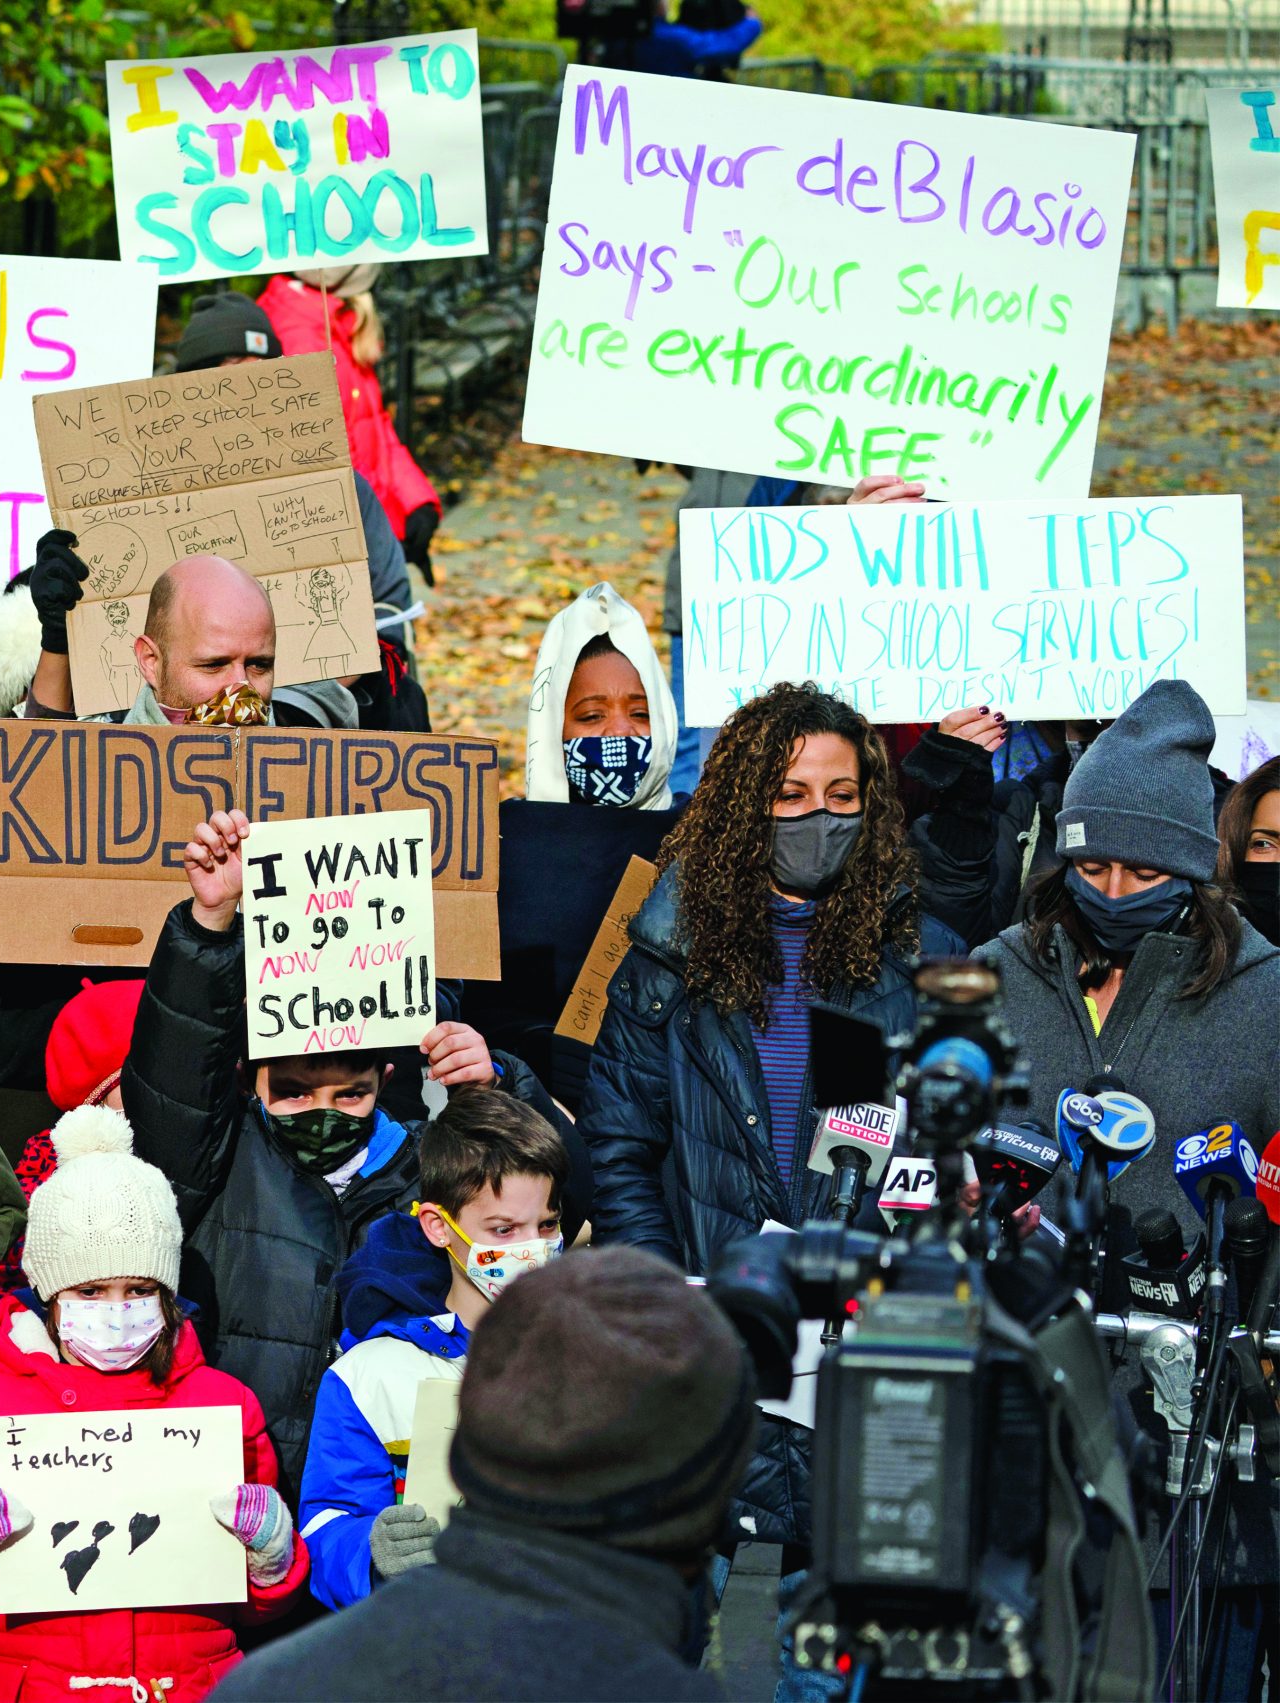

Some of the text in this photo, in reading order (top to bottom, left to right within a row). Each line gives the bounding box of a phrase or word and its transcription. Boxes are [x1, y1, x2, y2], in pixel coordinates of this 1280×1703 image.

[122, 42, 475, 133] I WANT TO
[176, 109, 390, 185] STAY IN
[575, 80, 784, 234] Mayor
[135, 169, 475, 275] SCHOOL
[55, 397, 105, 430] WE
[183, 378, 238, 400] OUR
[247, 369, 302, 399] JOB
[136, 414, 186, 441] KEEP
[192, 404, 267, 429] SCHOOL
[271, 392, 321, 415] SAFE
[540, 319, 1094, 481] are extraordinarily
[57, 457, 110, 485] DO
[132, 438, 196, 493] YOUR
[213, 433, 254, 463] JOB
[291, 418, 333, 440] KEEP
[203, 454, 284, 483] REOPEN
[291, 441, 337, 463] OUR
[178, 526, 202, 542] OUR
[271, 528, 288, 541] GO
[711, 510, 829, 585] KIDS
[848, 507, 989, 591] WITH
[89, 564, 114, 593] BARS
[688, 592, 791, 682] NEED
[808, 597, 847, 675] IN
[862, 601, 981, 672] SCHOOL
[245, 735, 498, 881] FIRST
[248, 838, 423, 900] I WANT
[305, 880, 361, 915] NOW
[311, 916, 349, 950] go
[259, 936, 416, 984] NOW NOW
[304, 1019, 367, 1052] NOW
[834, 1104, 892, 1134] INSIDE
[1069, 1099, 1103, 1123] abc
[831, 1121, 887, 1144] EDITION
[1206, 1124, 1232, 1153] 2
[1176, 1147, 1232, 1173] NEWS
[887, 1168, 936, 1193] AP
[1130, 1282, 1161, 1300] NEWS
[163, 1427, 201, 1448] my
[11, 1445, 113, 1473] teachers
